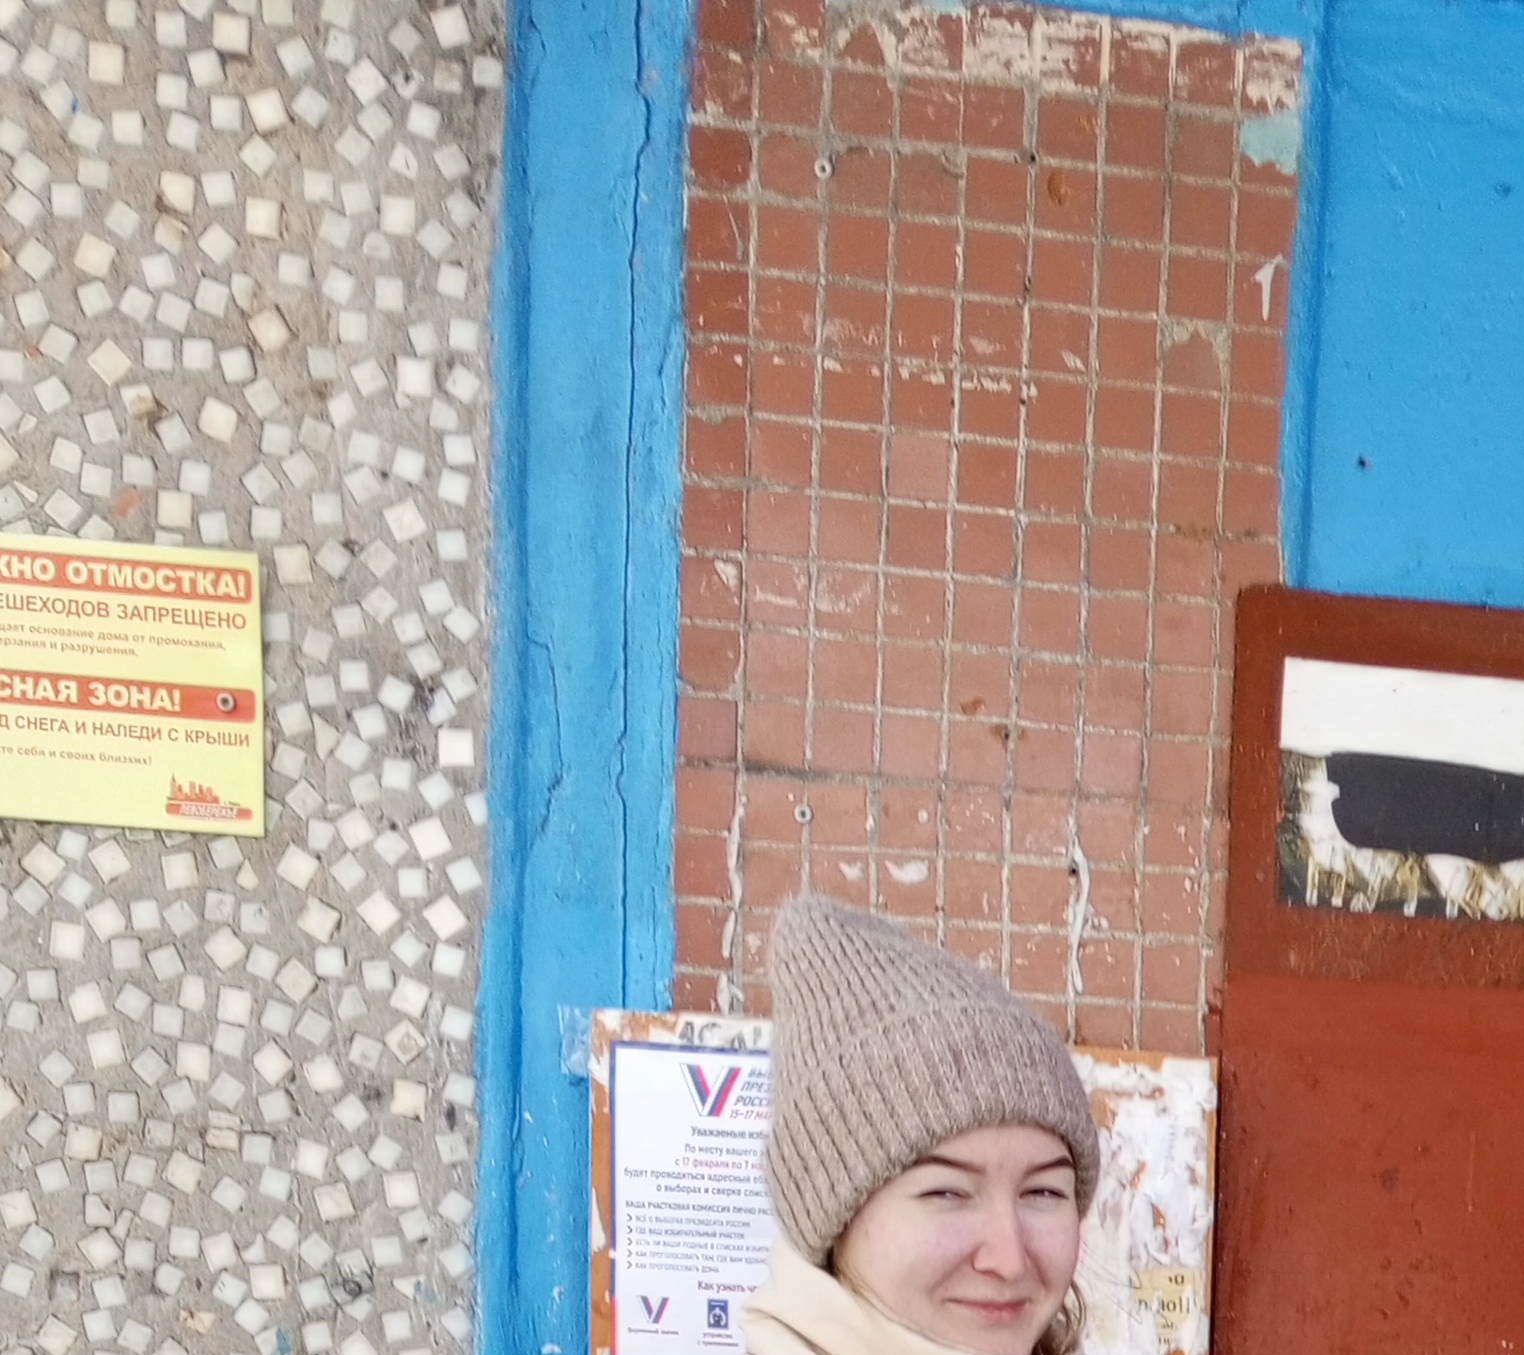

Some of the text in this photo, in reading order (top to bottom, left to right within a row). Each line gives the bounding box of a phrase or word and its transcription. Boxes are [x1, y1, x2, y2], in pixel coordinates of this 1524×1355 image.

[64, 560, 248, 599] ОТМОСТКА!
[117, 602, 247, 631] ЗАПРЕЩЕНО
[29, 624, 94, 640] основание
[97, 631, 129, 643] дома
[132, 634, 146, 643] от
[88, 681, 182, 713] ЗОНА!
[15, 715, 70, 734] СНЕГА
[75, 721, 87, 735] И
[92, 722, 163, 742] НАЛЕДИ
[168, 728, 180, 742] С
[185, 729, 250, 747] КРЫШИ
[17, 745, 46, 757] себя
[49, 748, 57, 758] и
[60, 749, 96, 761] своих
[690, 1126, 746, 1140] Уважаемые
[685, 1143, 696, 1154] По
[698, 1146, 724, 1157] месту
[726, 1147, 758, 1157] вашего
[692, 1158, 729, 1171] февраля
[624, 1167, 648, 1180] будет
[650, 1169, 705, 1182] проводиться
[707, 1172, 751, 1184] адресный
[664, 1183, 702, 1195] выборах
[711, 1187, 742, 1198] сверке
[647, 1201, 690, 1212] УЧАСТКОВАЯ
[692, 1204, 731, 1214] КОМИССИЯ
[697, 1280, 714, 1291] Как
[716, 1282, 745, 1294] узнать
